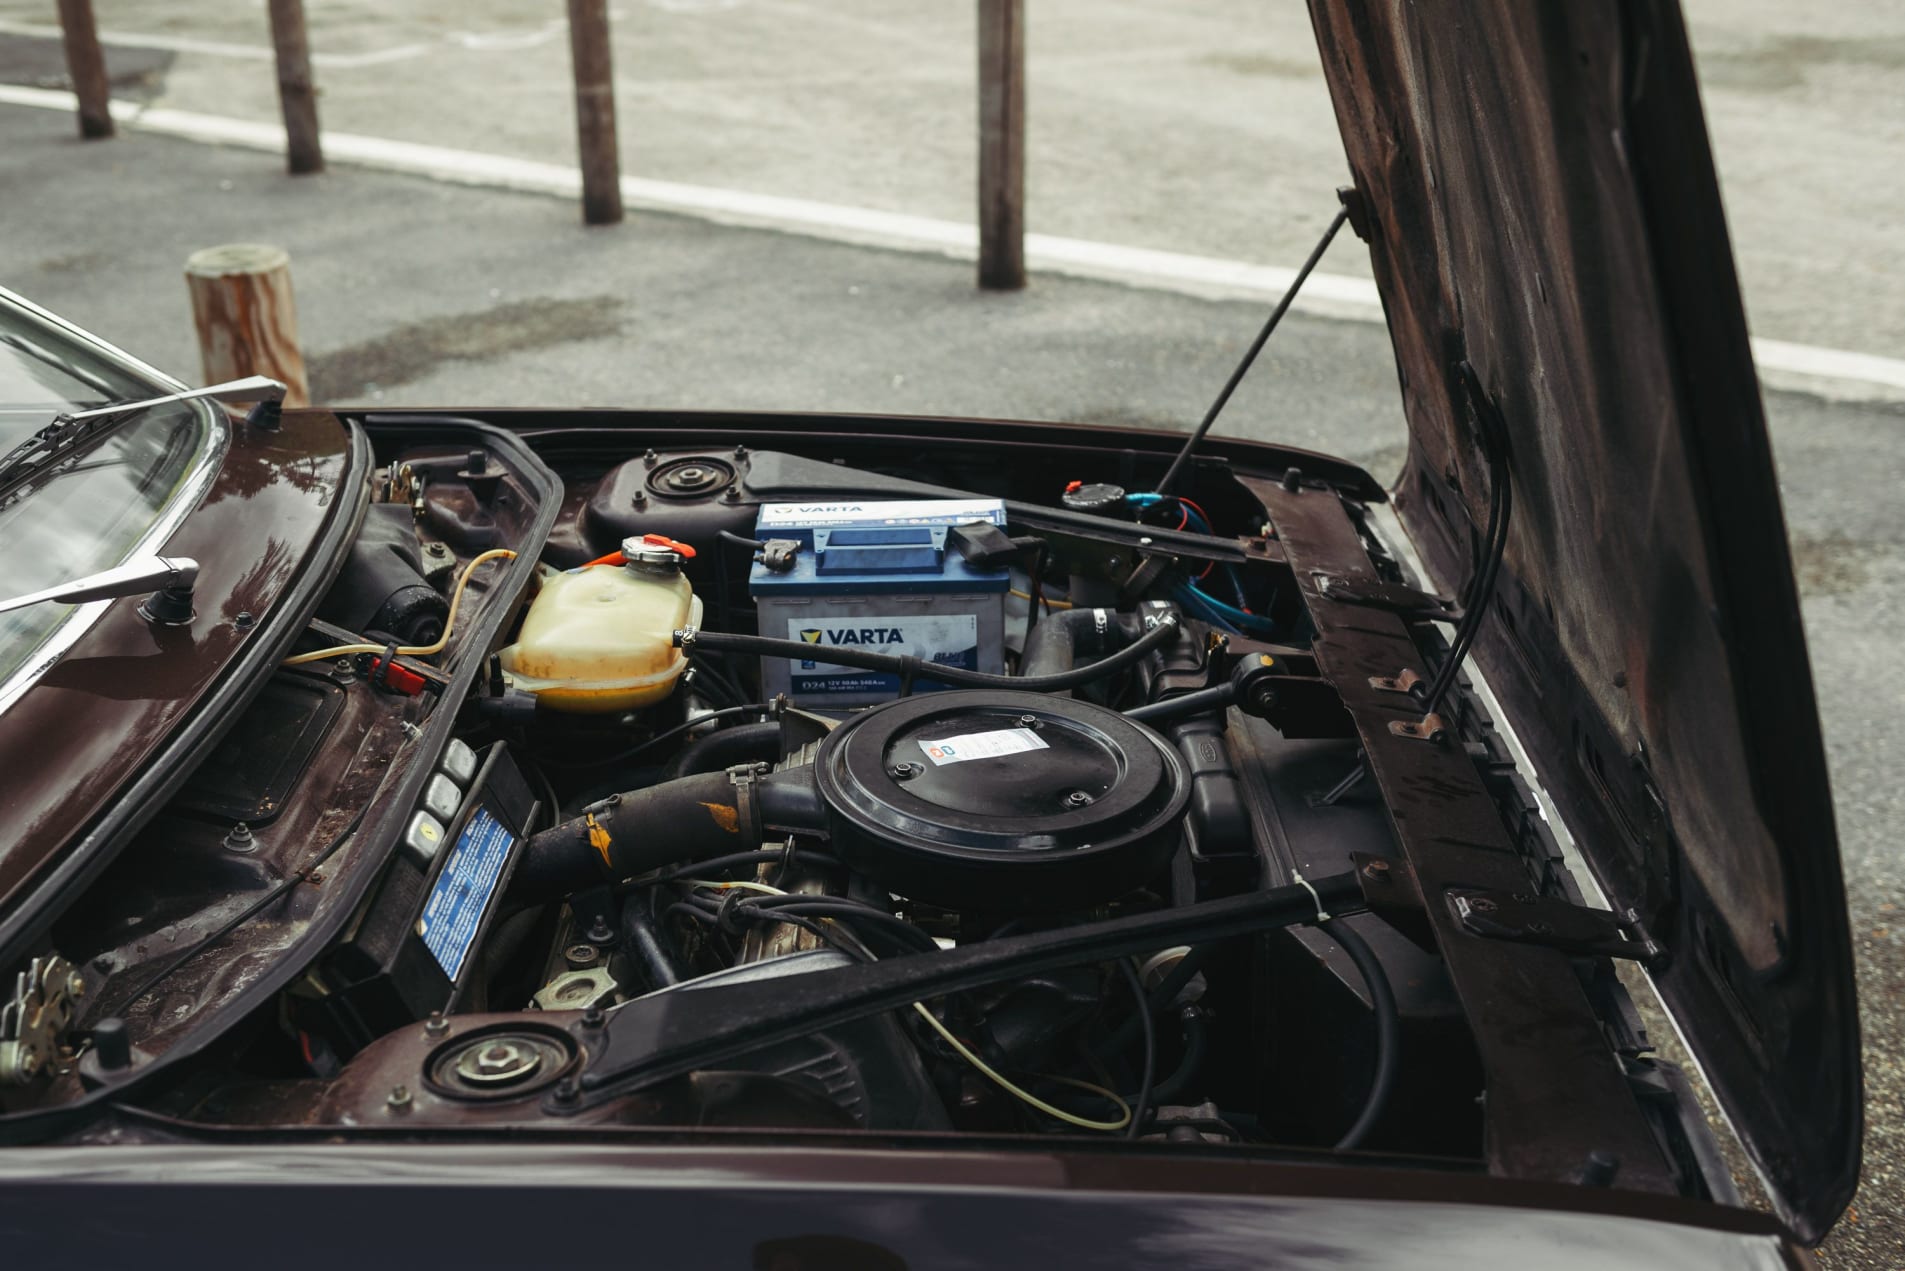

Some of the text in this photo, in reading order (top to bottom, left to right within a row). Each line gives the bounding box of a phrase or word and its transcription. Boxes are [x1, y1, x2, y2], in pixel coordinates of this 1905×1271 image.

[799, 506, 863, 514] VARTA
[826, 628, 904, 645] VARTA
[801, 681, 826, 690] D24
